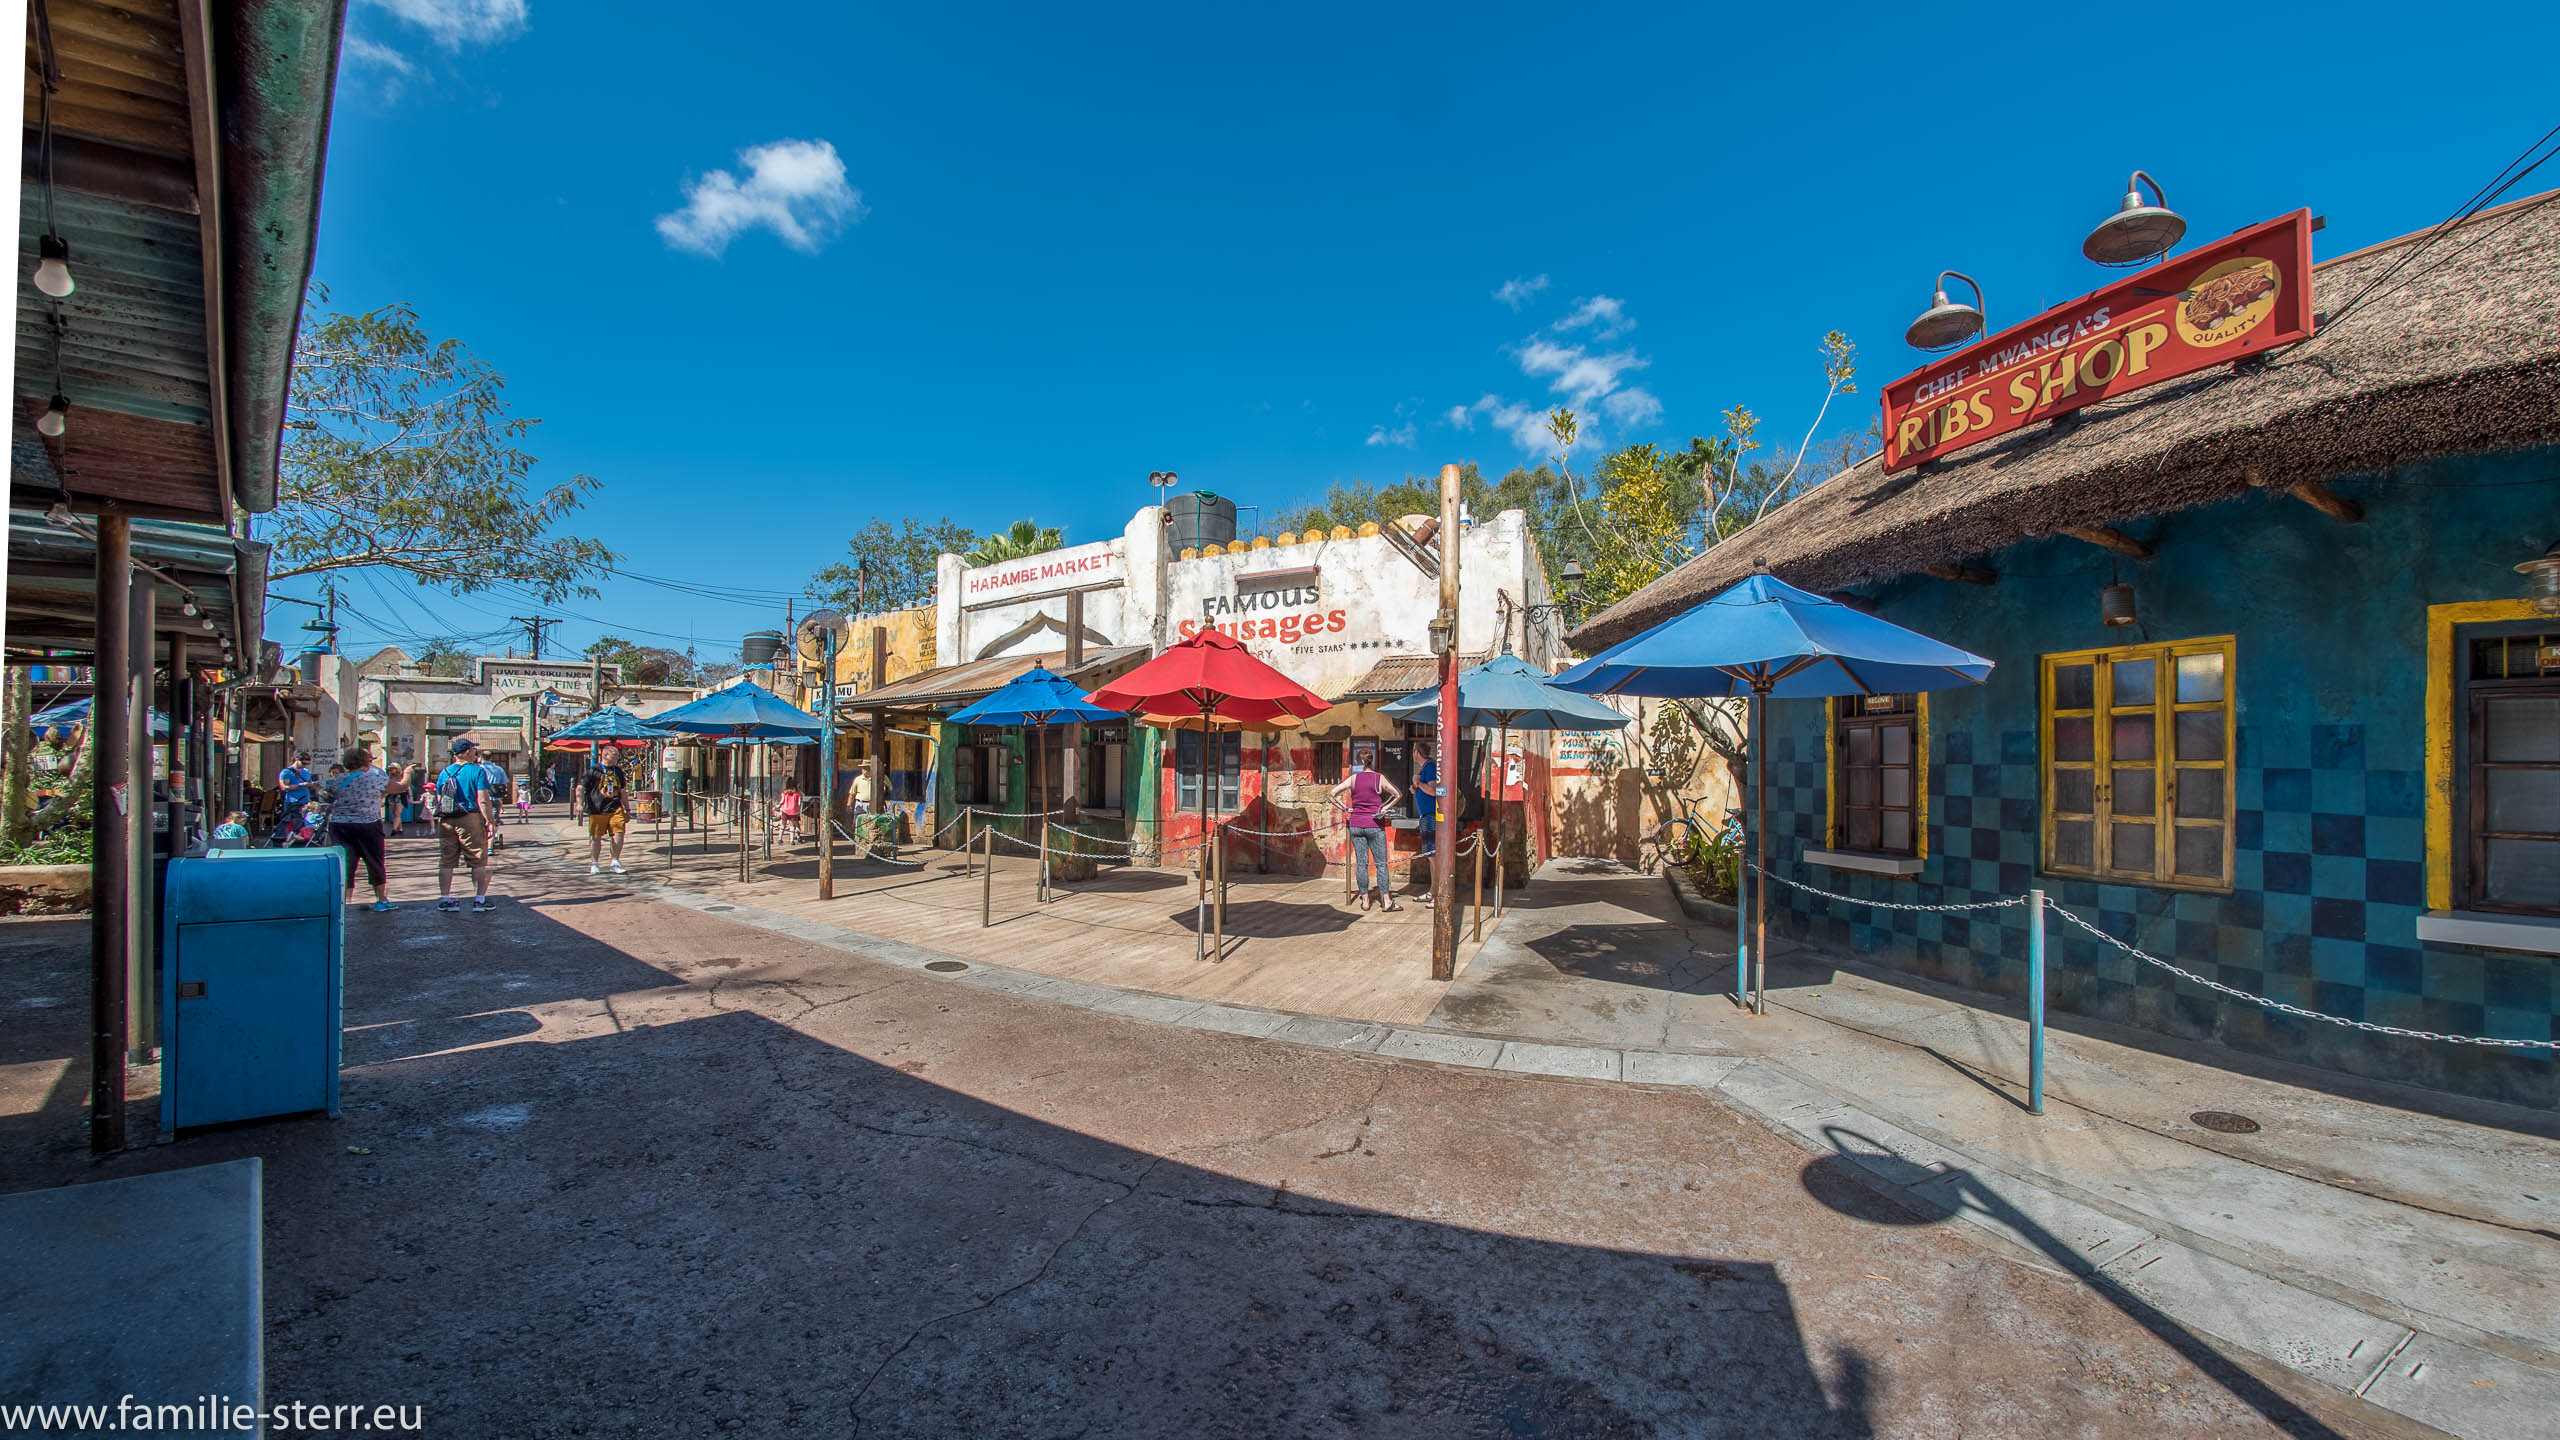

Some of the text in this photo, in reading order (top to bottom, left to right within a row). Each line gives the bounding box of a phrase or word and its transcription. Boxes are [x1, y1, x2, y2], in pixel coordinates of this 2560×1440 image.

[2193, 314, 2257, 344] QUALITY
[1914, 307, 2110, 403] CHEF MWANGA'S
[1897, 323, 2169, 459] RIBS SHOP
[970, 552, 1115, 593] HARAMBE MARKET
[1202, 585, 1320, 617] FAMOUS
[1178, 609, 1346, 645] Susages
[491, 678, 525, 688] HAVE
[531, 679, 540, 689] A
[540, 670, 562, 678] SIKU
[1562, 738, 1592, 748] MOST
